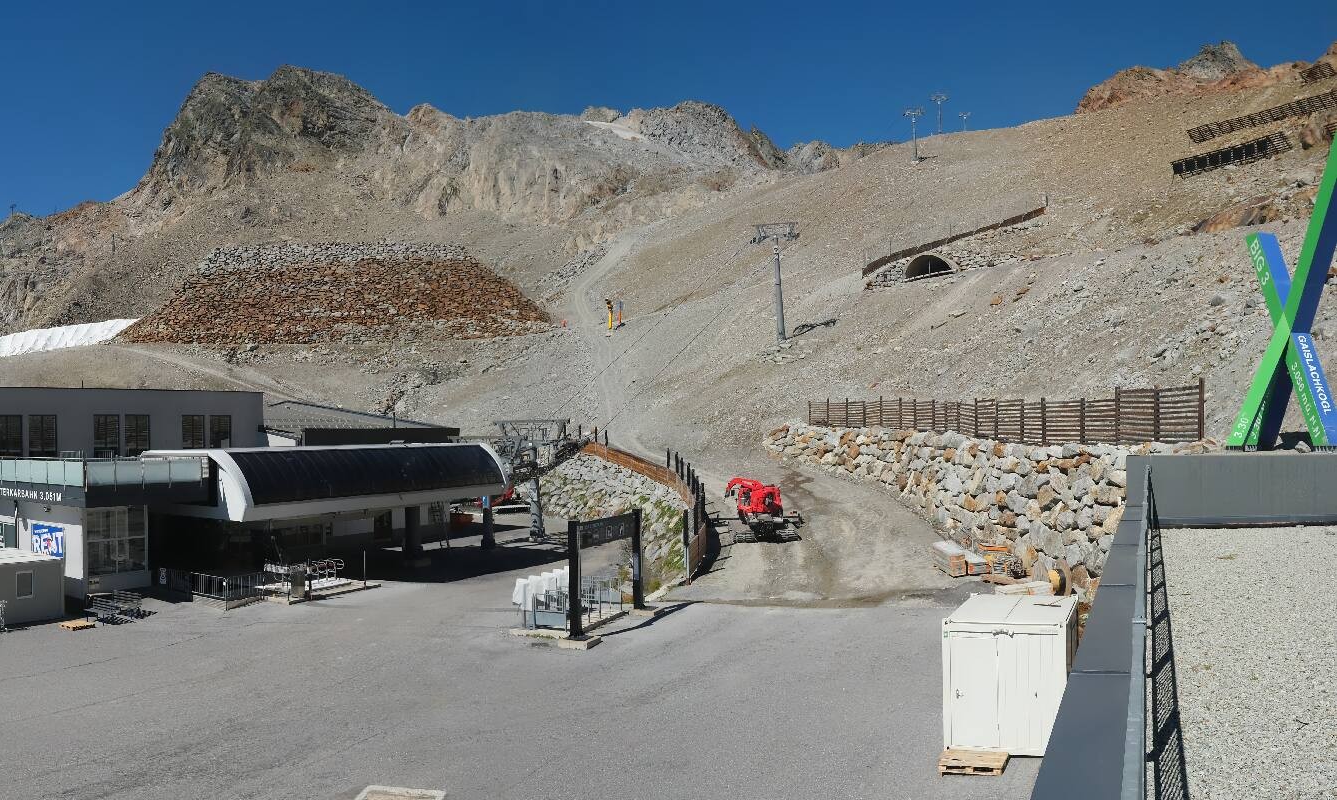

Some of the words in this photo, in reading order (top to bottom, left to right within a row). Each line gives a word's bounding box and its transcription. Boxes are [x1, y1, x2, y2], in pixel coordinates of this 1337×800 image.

[1249, 238, 1265, 273] BIG
[1261, 271, 1270, 286] 3
[1297, 335, 1332, 415] GAISLACHKOGL
[32, 531, 64, 556] RENT
